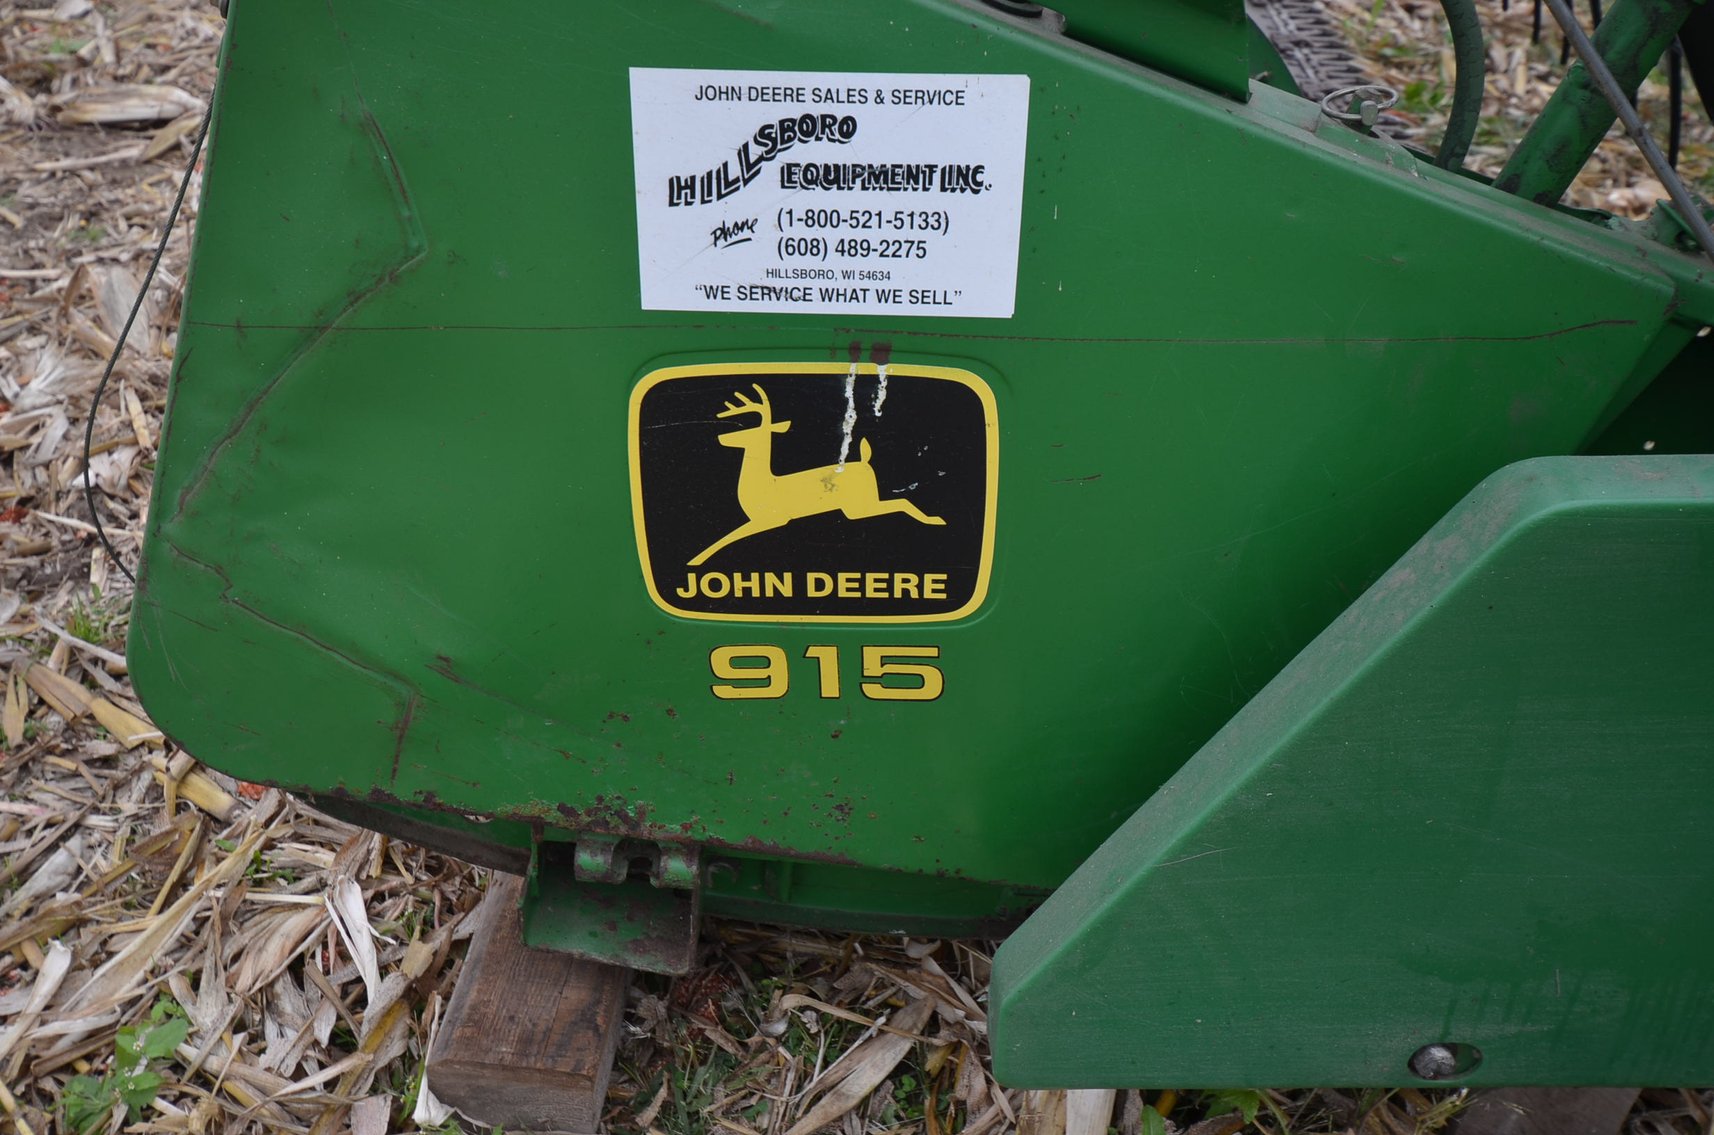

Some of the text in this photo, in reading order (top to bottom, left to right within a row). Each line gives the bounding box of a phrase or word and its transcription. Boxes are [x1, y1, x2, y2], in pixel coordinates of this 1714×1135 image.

[695, 85, 966, 106] JOHN DEERE SALES & SERVICE
[668, 113, 857, 207] HILLSBORO
[780, 162, 992, 194] EQUIPMENT INC.
[777, 208, 949, 235] (1-800-521-5133)
[777, 237, 927, 261] (608) 489-2275
[766, 268, 891, 282] HILLSBORO, WI 54634
[737, 285, 813, 303] SERVICE
[819, 288, 871, 303] WHAT
[875, 289, 903, 304] WE
[676, 572, 948, 600] JOHN DEERE
[709, 644, 945, 702] 915
